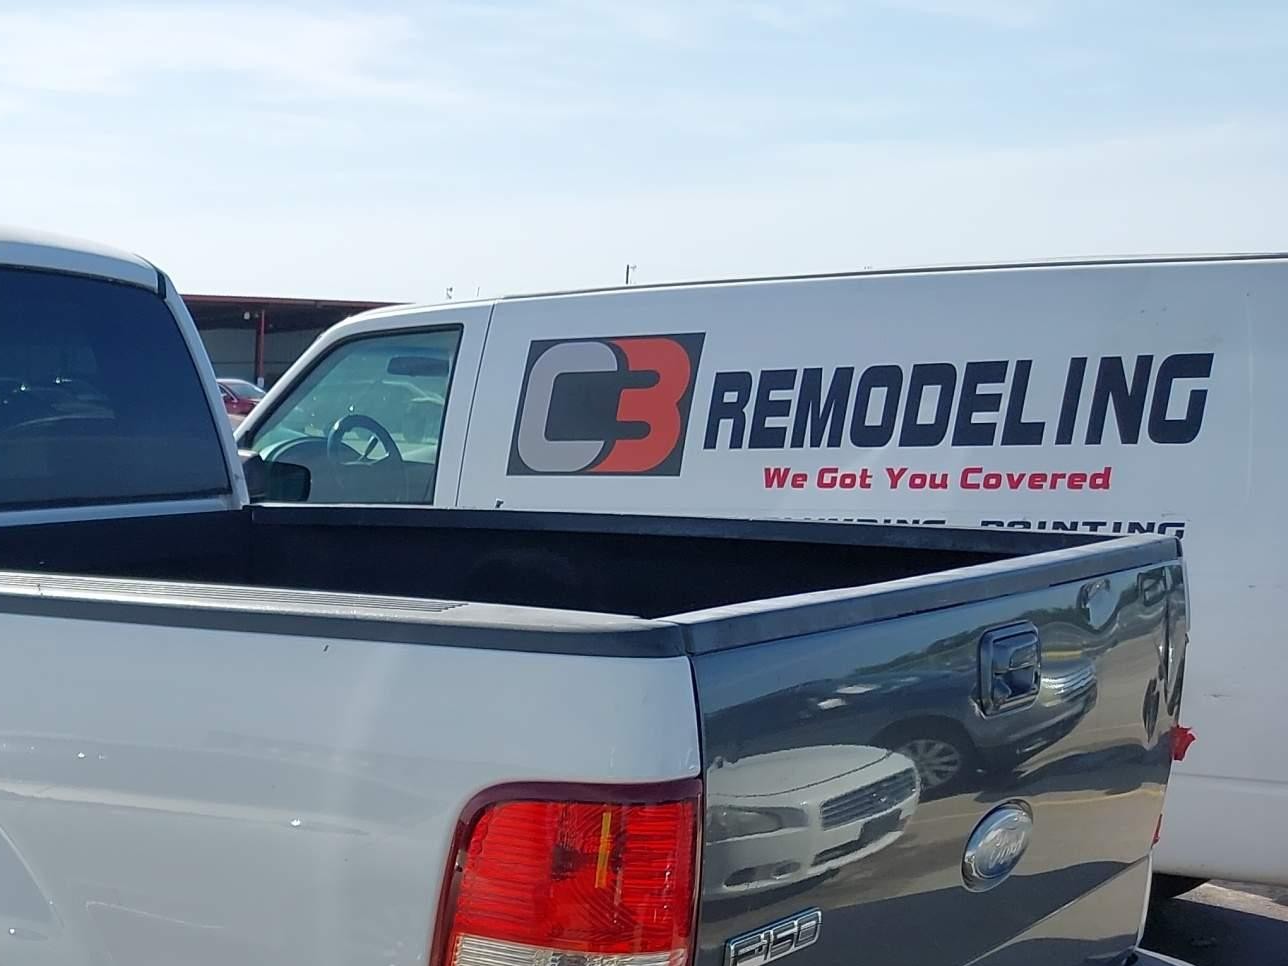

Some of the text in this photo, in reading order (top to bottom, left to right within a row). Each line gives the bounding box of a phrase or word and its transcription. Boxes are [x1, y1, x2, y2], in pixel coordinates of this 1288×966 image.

[703, 352, 1215, 450] REMODELING
[763, 466, 1114, 491] We Got You Covered
